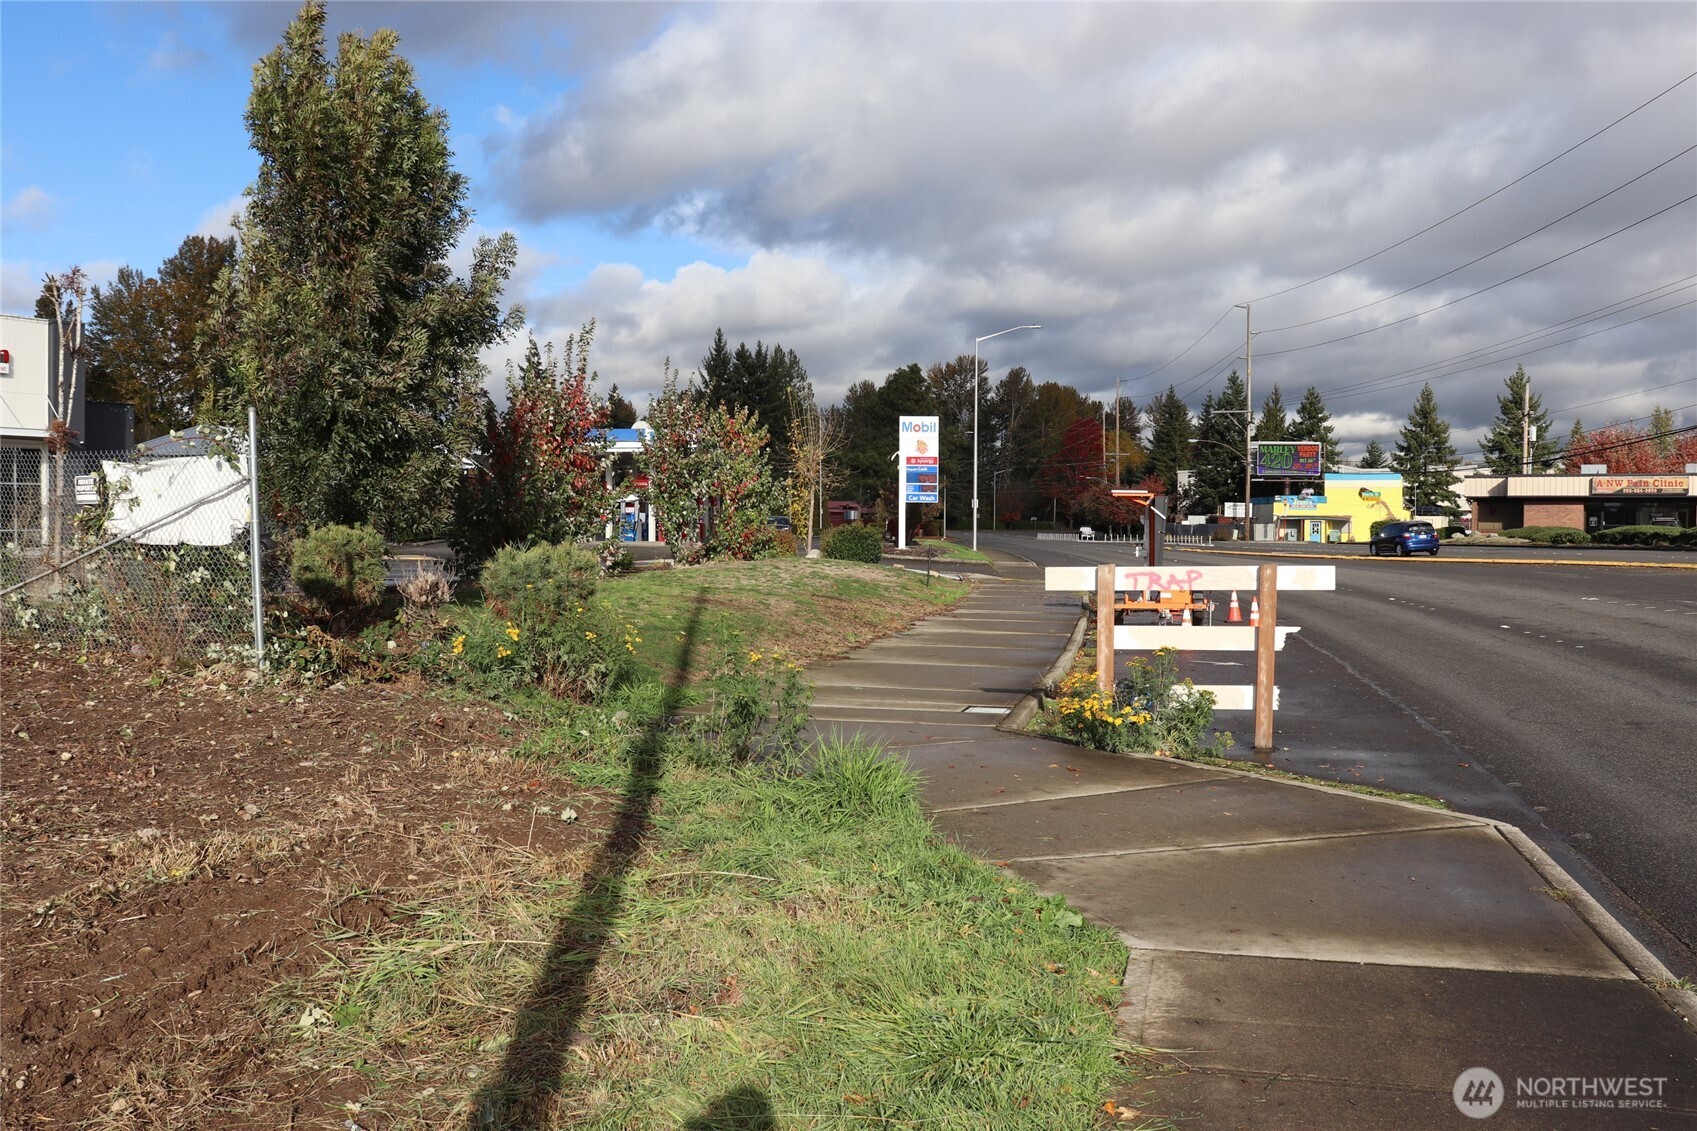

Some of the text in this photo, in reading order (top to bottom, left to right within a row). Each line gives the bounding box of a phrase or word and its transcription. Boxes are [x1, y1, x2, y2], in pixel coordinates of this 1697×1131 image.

[902, 421, 936, 432] Mobil
[1260, 445, 1297, 454] MARLEY
[1260, 453, 1293, 469] 420
[1596, 479, 1684, 488] A NW Pain Clinic
[1124, 569, 1203, 591] TRAP
